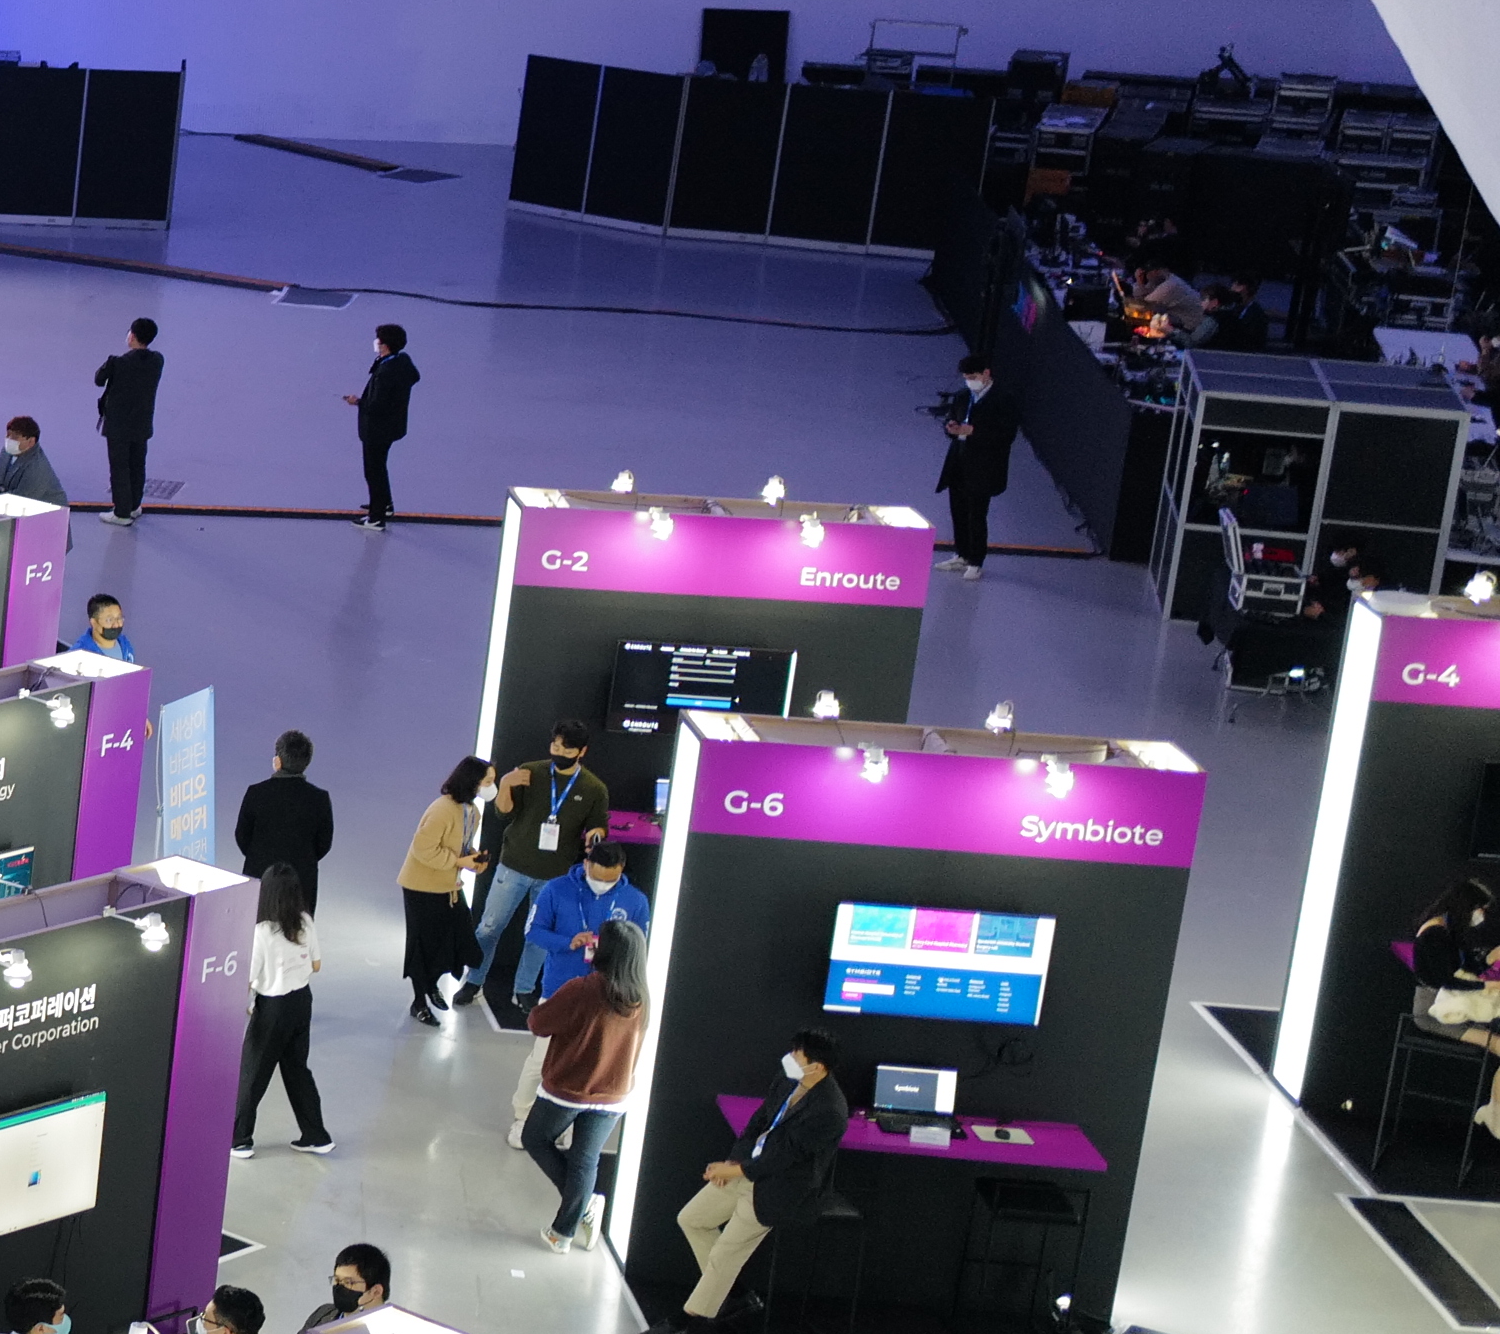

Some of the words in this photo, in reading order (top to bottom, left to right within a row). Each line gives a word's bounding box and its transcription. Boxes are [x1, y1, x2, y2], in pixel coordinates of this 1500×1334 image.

[25, 561, 53, 585] F-2
[541, 549, 589, 573] G-2
[800, 566, 901, 593] Enroute
[1402, 663, 1460, 688] G-4
[100, 728, 134, 756] F-4
[168, 710, 207, 744] 세상이
[168, 740, 207, 775] 바라던
[169, 773, 208, 808] 비디오
[724, 790, 784, 818] G-6
[170, 804, 208, 841] 메이커
[1020, 815, 1164, 848] Symbiote
[201, 950, 238, 983] F-6
[11, 1013, 100, 1053] Corporation
